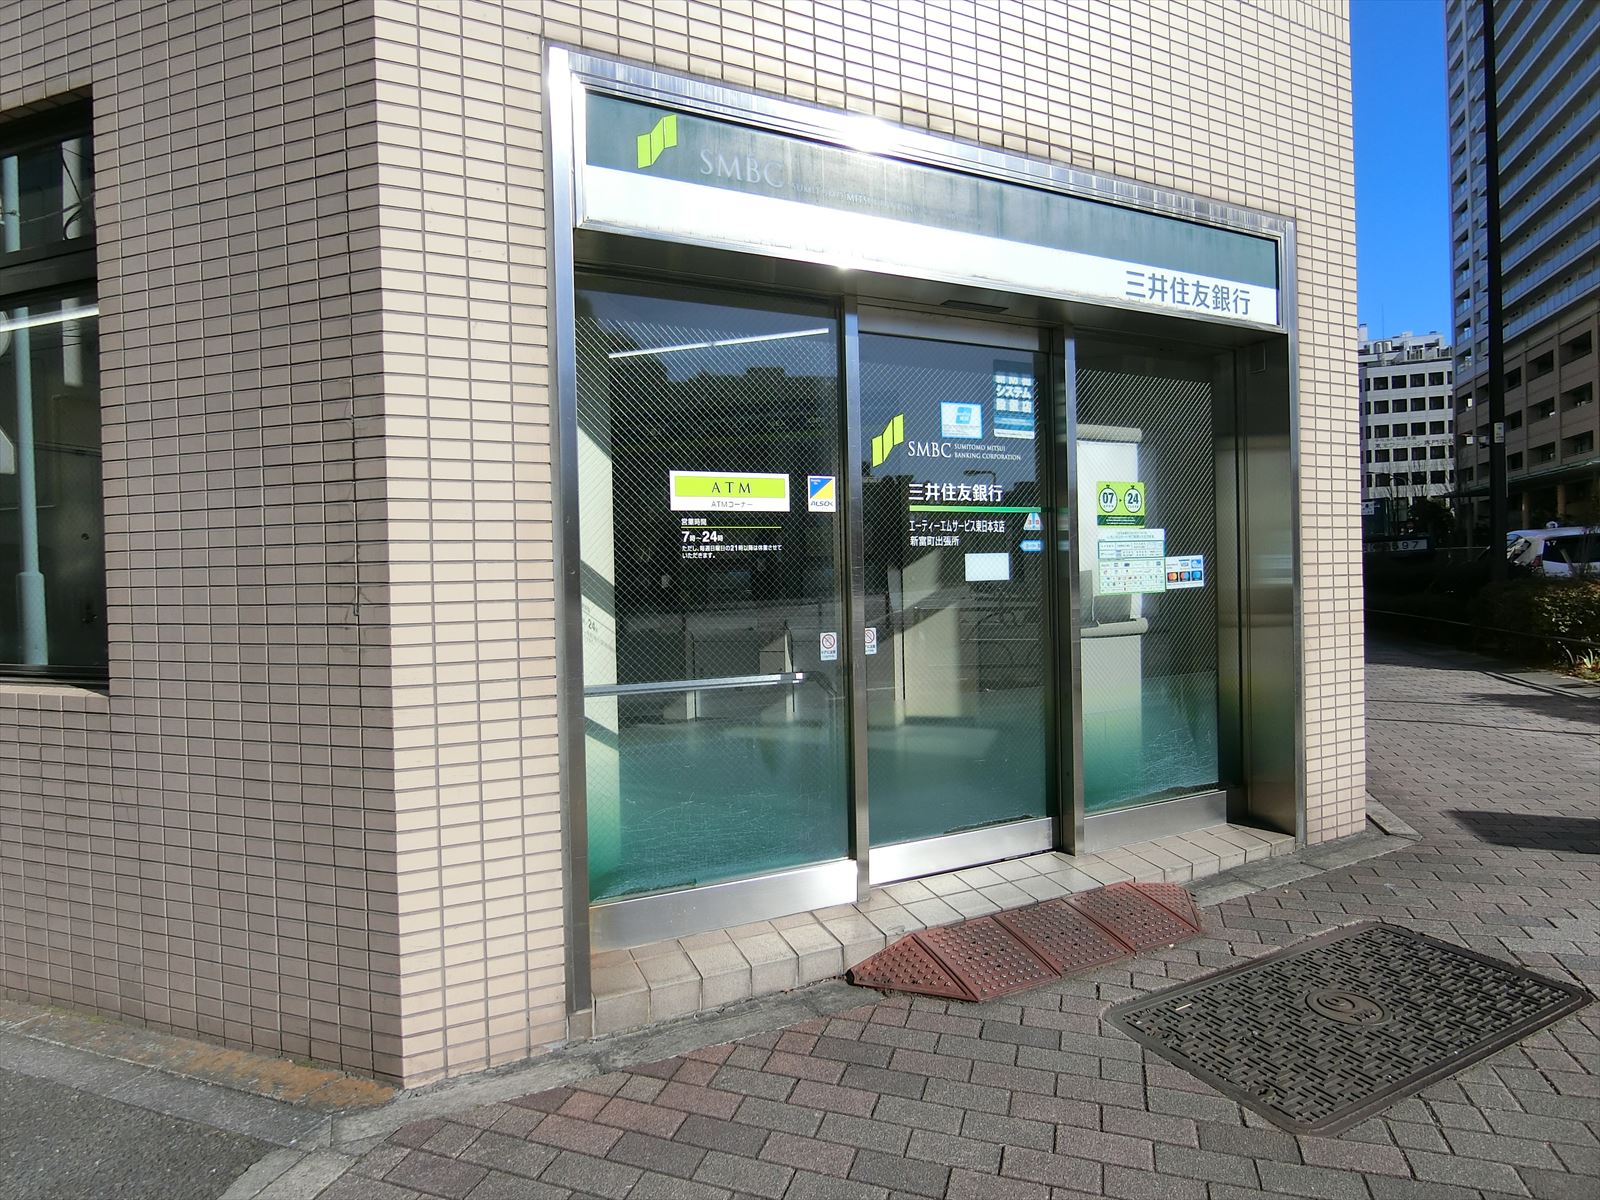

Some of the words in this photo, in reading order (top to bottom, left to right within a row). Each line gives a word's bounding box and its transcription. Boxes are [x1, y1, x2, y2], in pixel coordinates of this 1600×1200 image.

[700, 148, 784, 188] SMBC
[1126, 270, 1251, 315] 三井住友銀行
[908, 441, 952, 458] SMBC
[954, 443, 986, 451] SUMITOMO
[982, 453, 1021, 461] CORPORATION
[711, 481, 751, 494] ATM
[908, 483, 1003, 502] 三井住友銀行
[1102, 492, 1114, 504] 07
[1127, 492, 1139, 504] 24
[909, 520, 1005, 533] エーティーエムサービス東日本支店
[910, 535, 959, 546] 新富町出張所
